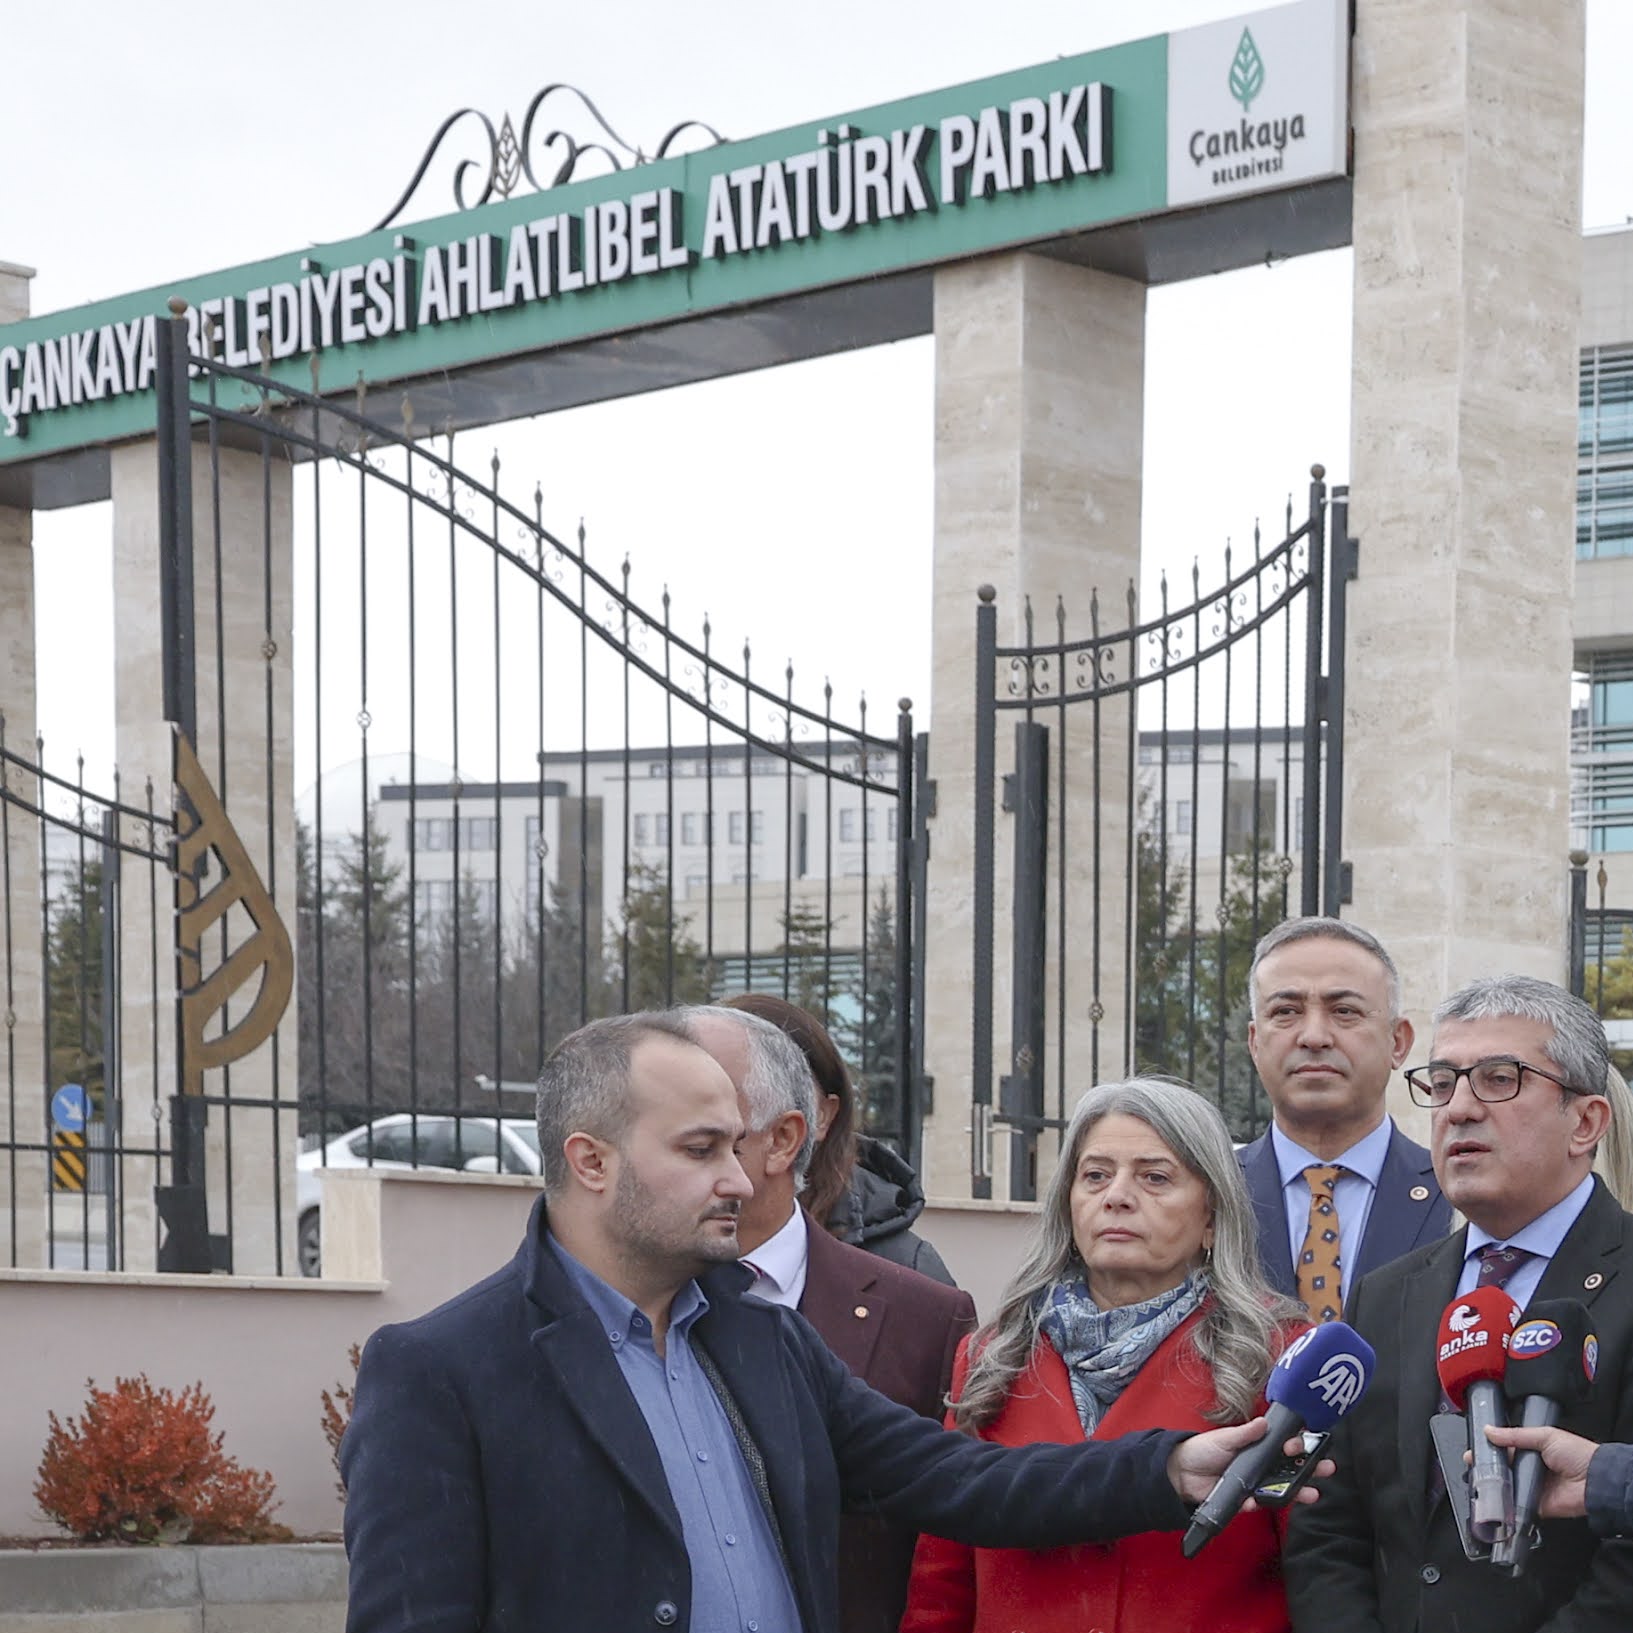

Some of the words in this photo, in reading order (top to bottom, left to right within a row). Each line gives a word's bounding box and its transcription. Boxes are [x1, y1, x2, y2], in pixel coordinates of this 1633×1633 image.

[1189, 113, 1306, 168] Çankaya
[1212, 156, 1284, 187] BELEDİYESİ
[2, 314, 158, 436] ÇANKAYA
[418, 188, 688, 325] AHLATLIBEL
[703, 124, 926, 258] ATATÜRK
[941, 82, 1102, 203] PARKI
[1440, 1330, 1489, 1357] anka
[1513, 1328, 1553, 1350] SZC
